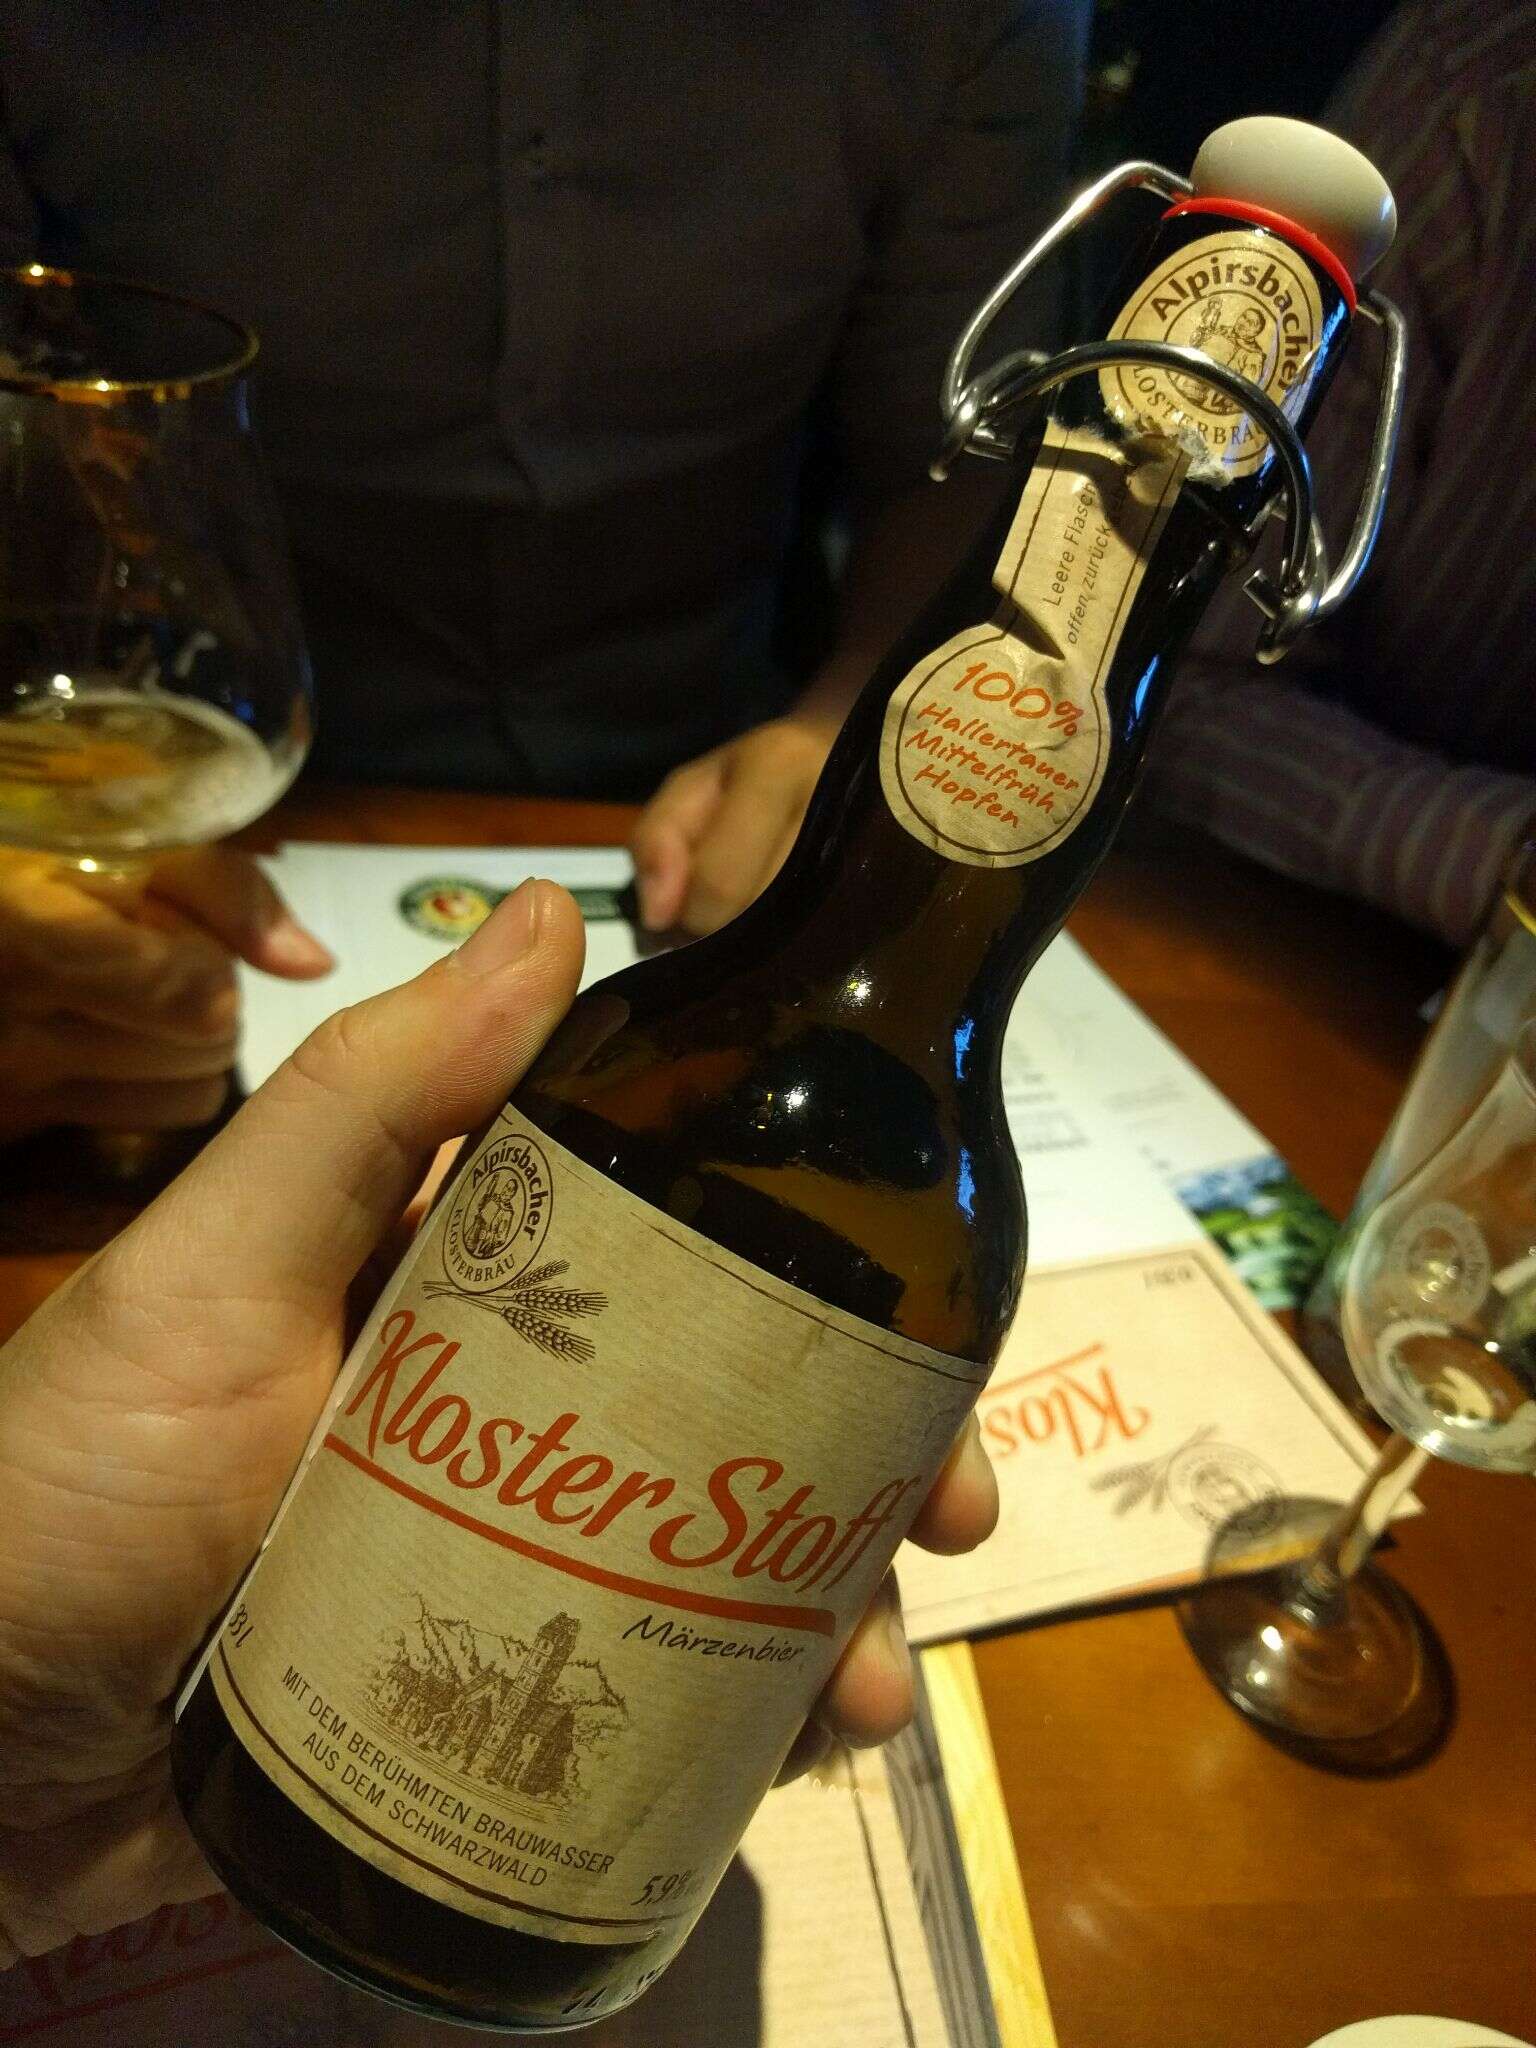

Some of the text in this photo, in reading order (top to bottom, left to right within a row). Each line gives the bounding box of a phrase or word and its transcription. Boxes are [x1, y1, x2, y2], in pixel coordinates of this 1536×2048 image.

[1042, 549, 1075, 607] Leere
[1067, 594, 1090, 645] offen
[953, 662, 1084, 737] 100%
[904, 728, 1054, 814] Mittelfrüh
[917, 702, 1080, 791] Hallertauer
[913, 763, 1019, 829] Hopfen
[471, 1140, 549, 1242] Alpirsbacher
[622, 1614, 804, 1665] Märzenbier
[282, 1665, 615, 1875] MIT DEM BERÜHMTEN BRAUWASSER
[302, 1732, 549, 1887] AUS DEM SCHWARZWALD
